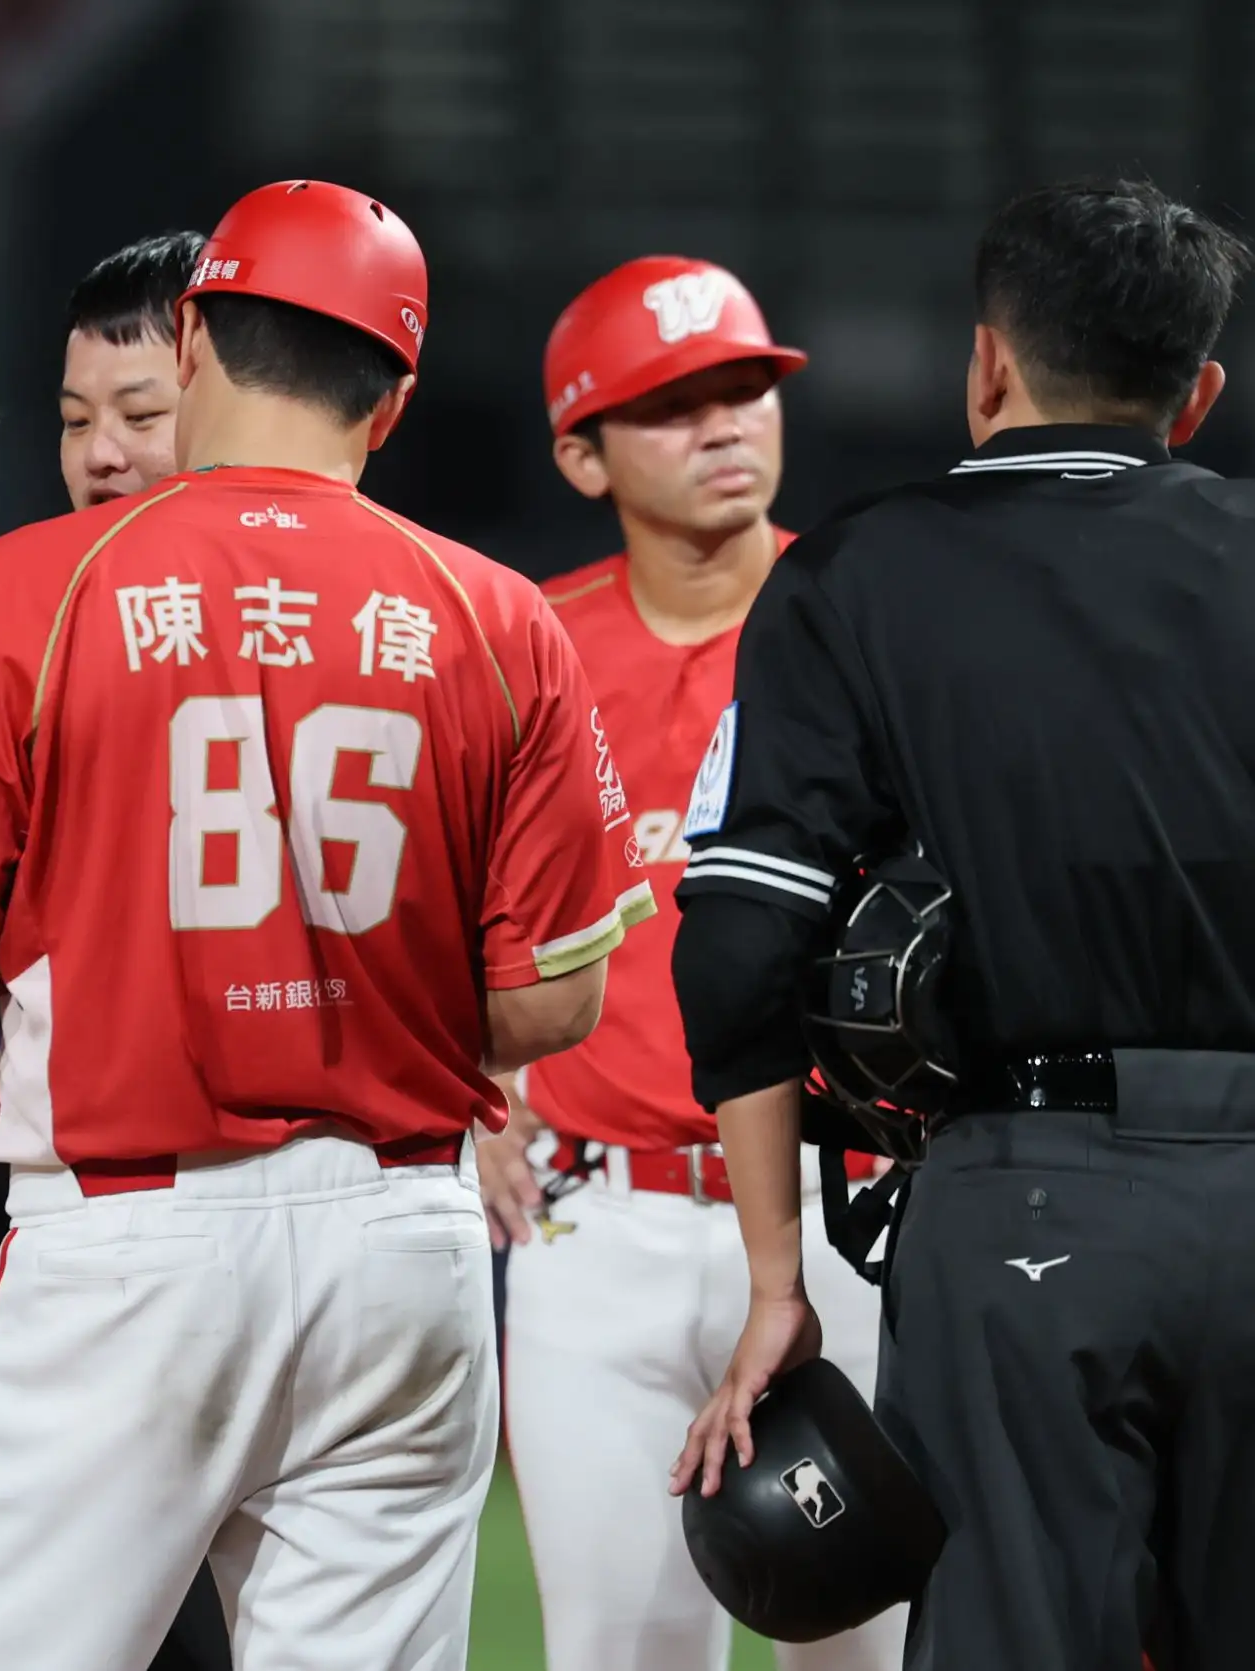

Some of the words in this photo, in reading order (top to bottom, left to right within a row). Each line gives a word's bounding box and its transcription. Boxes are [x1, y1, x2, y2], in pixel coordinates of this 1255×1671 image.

[240, 507, 307, 529] CPBL
[115, 576, 438, 683] 陳志偉
[169, 694, 422, 936] 86
